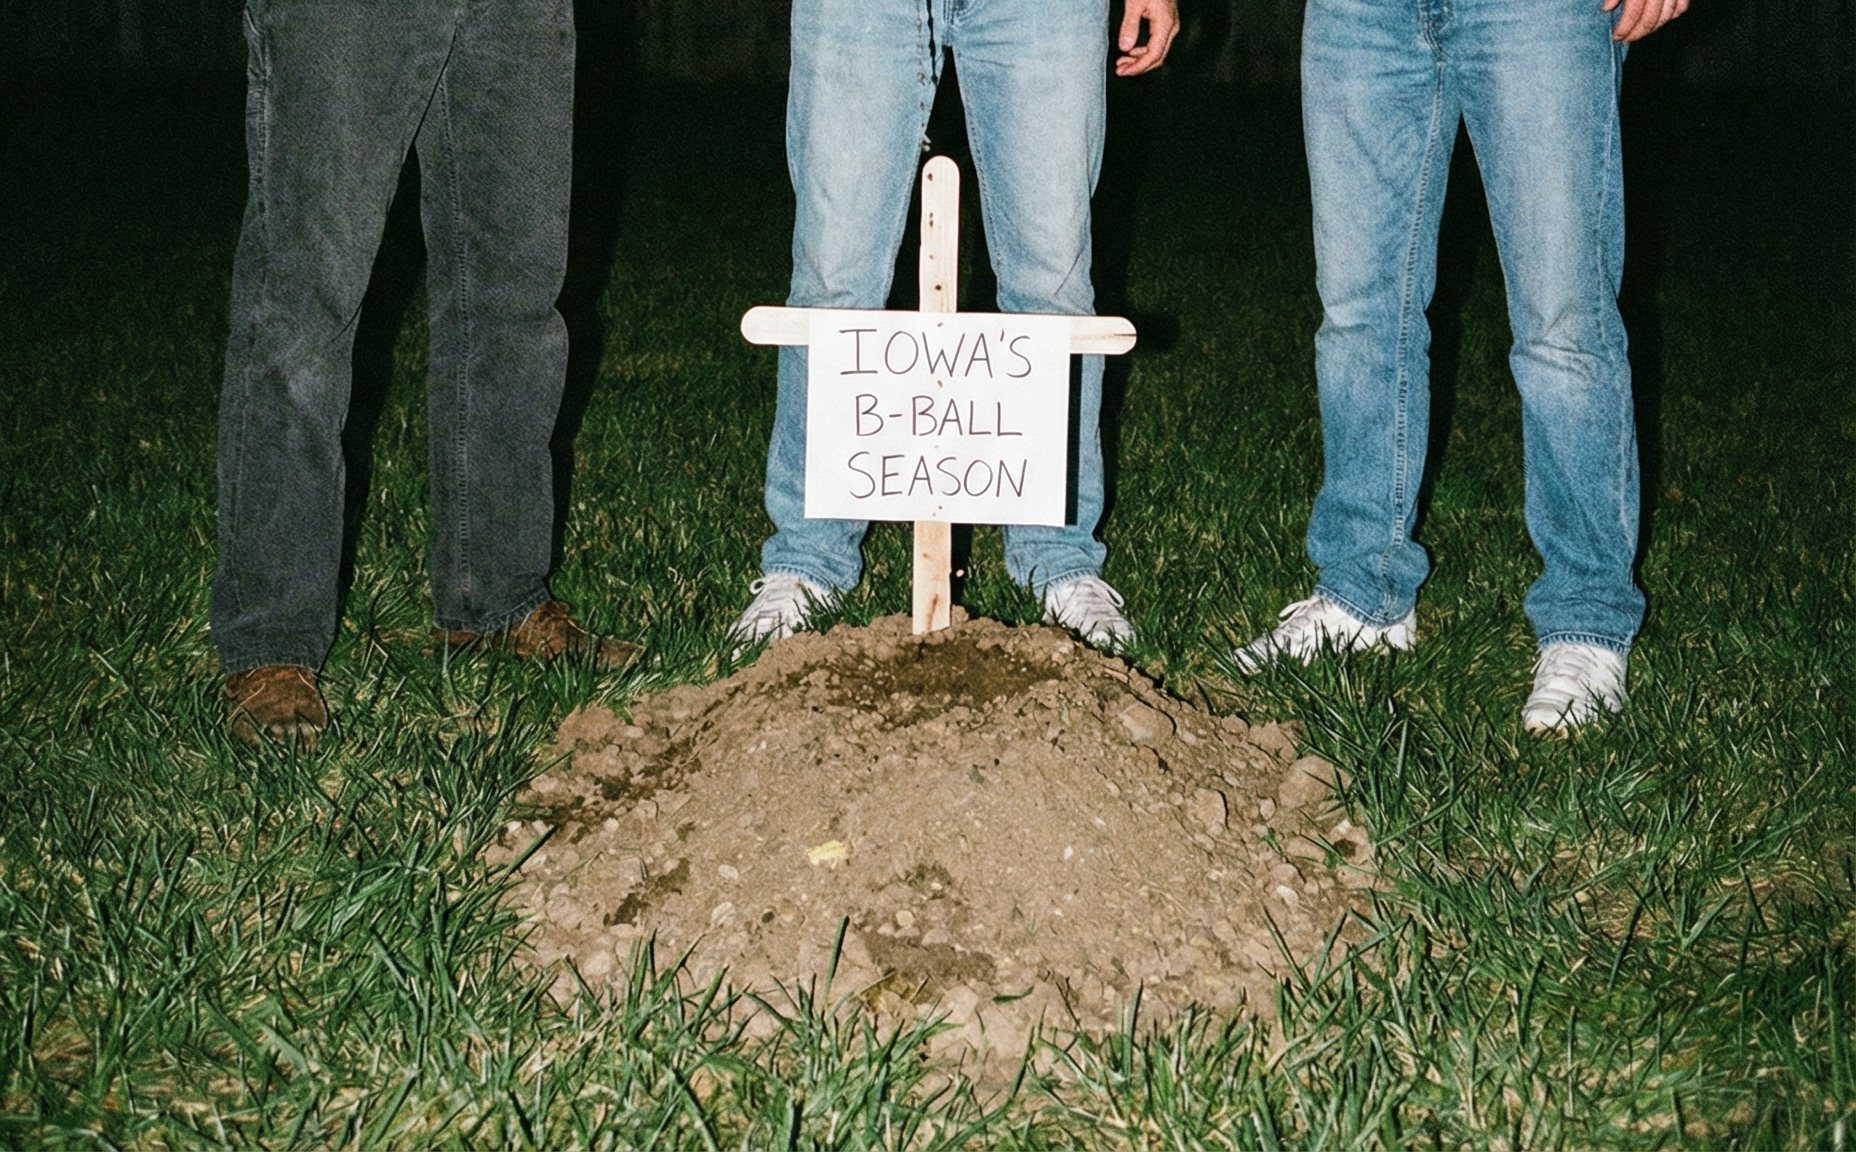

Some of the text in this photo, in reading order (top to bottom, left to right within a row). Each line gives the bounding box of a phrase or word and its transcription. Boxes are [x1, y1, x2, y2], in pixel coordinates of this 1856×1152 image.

[838, 328, 1032, 379] IOWA'S
[855, 393, 1023, 437] B-BALL
[847, 451, 1028, 499] SEASON
